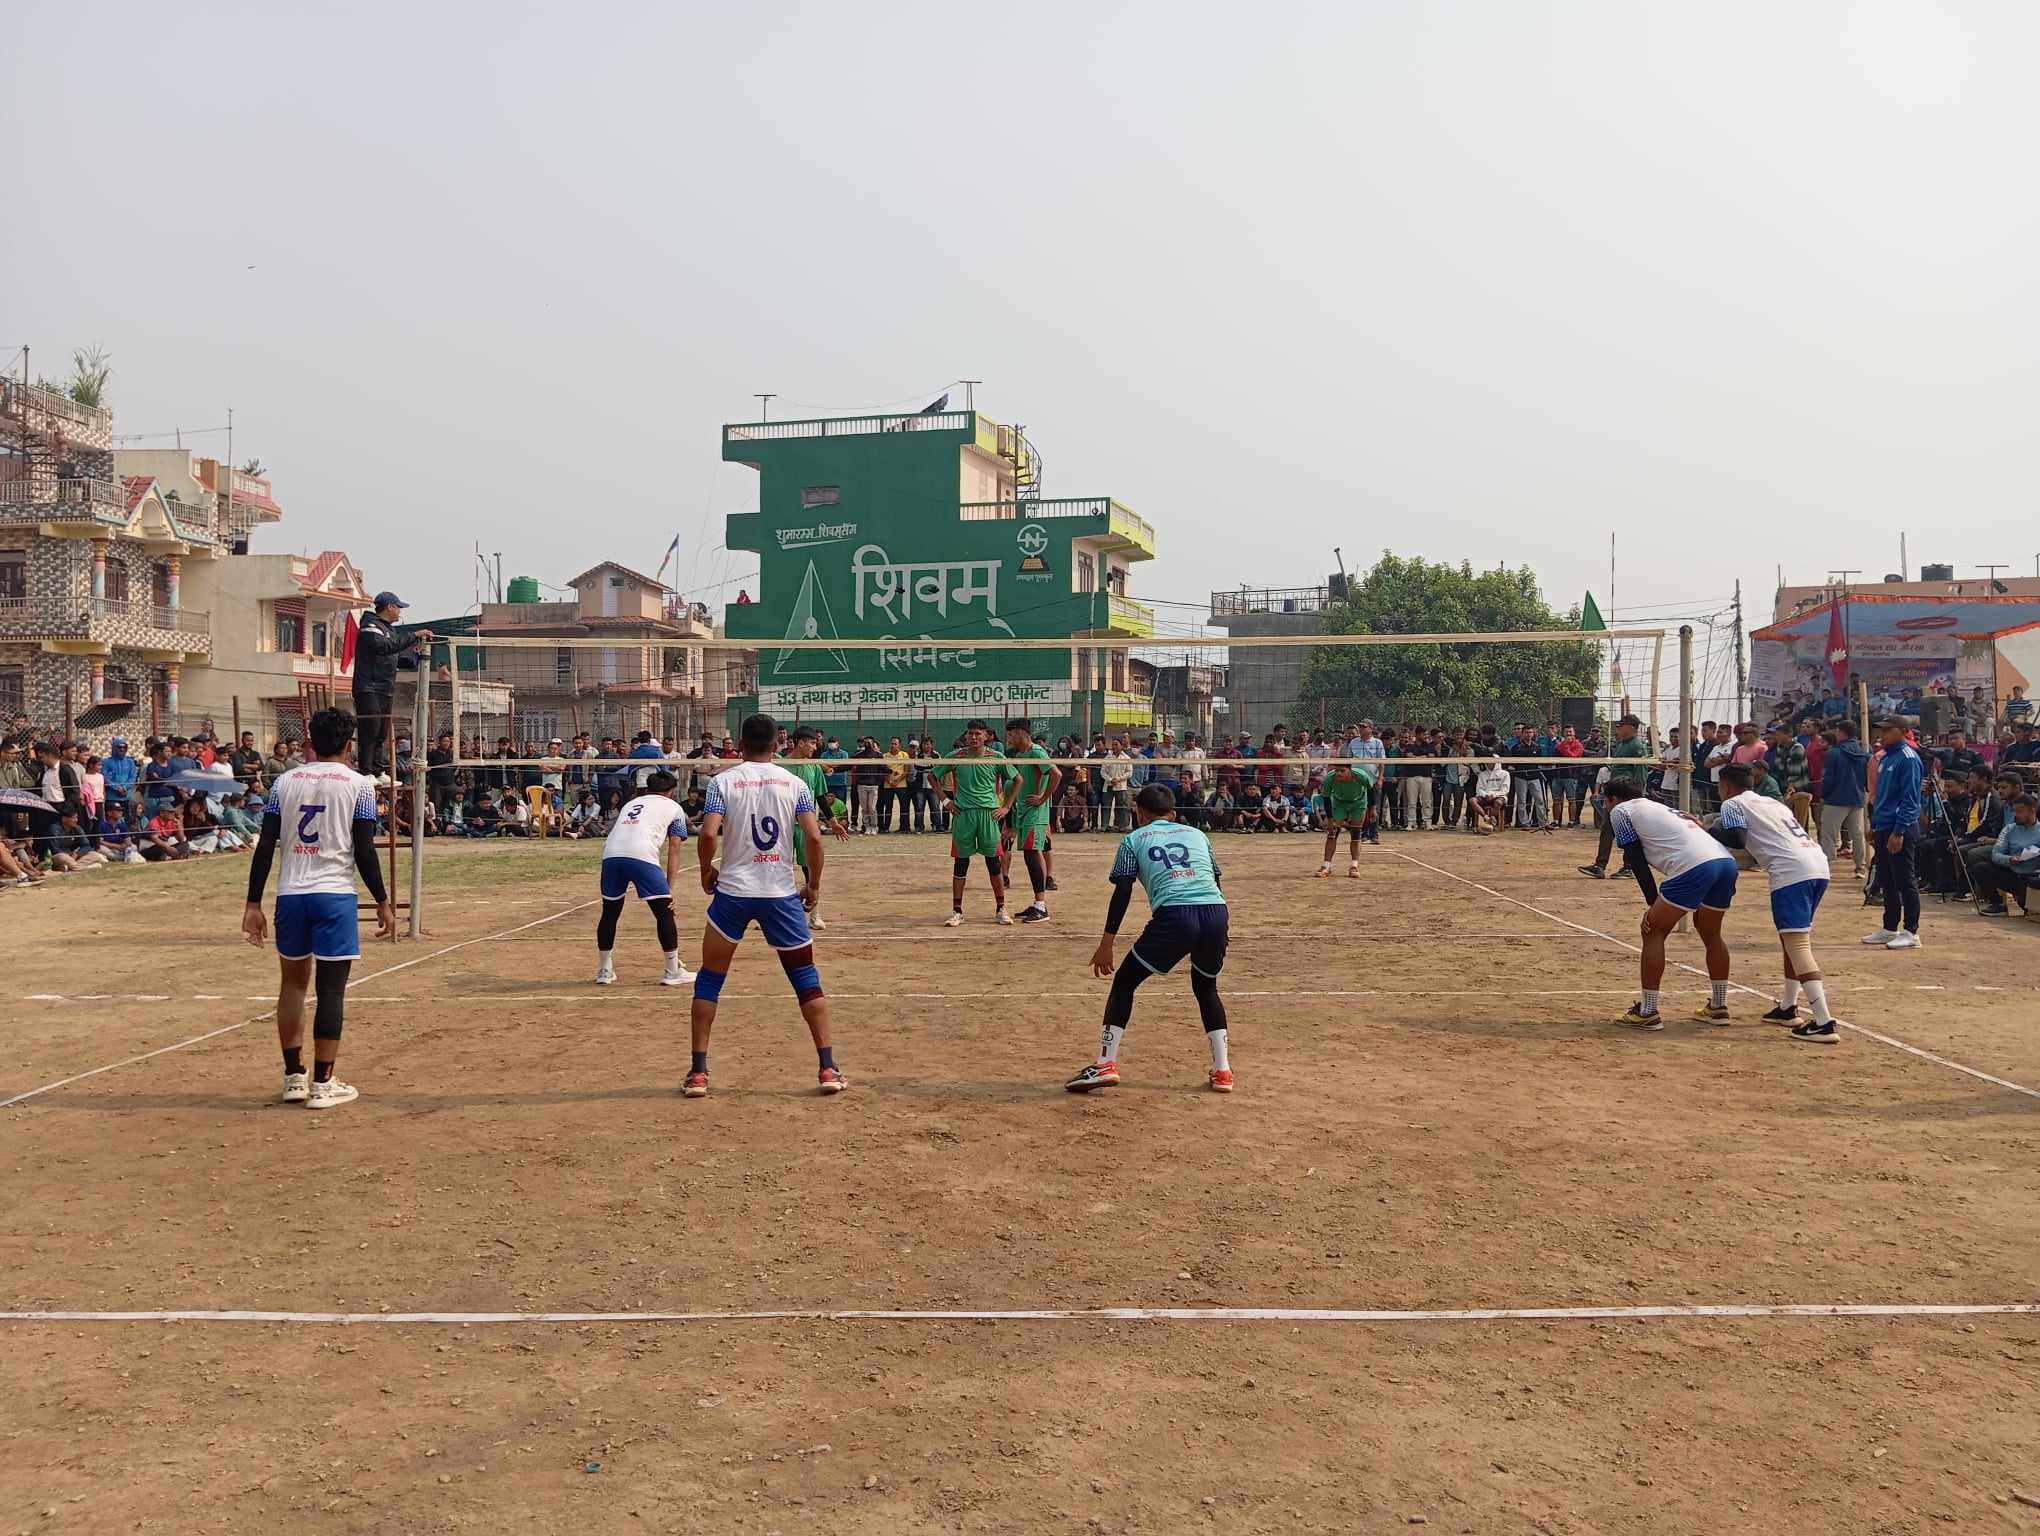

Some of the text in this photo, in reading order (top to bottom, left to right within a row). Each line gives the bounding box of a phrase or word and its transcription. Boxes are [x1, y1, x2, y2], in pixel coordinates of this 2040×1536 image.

[802, 690, 829, 705] तथा
[859, 687, 898, 704] ग्रेडको
[904, 686, 968, 707] गुणस्तरीय
[971, 686, 1004, 704] OPC
[1006, 684, 1050, 701] सिमेन्ट
[750, 813, 780, 852] ७
[1148, 842, 1191, 870] १२
